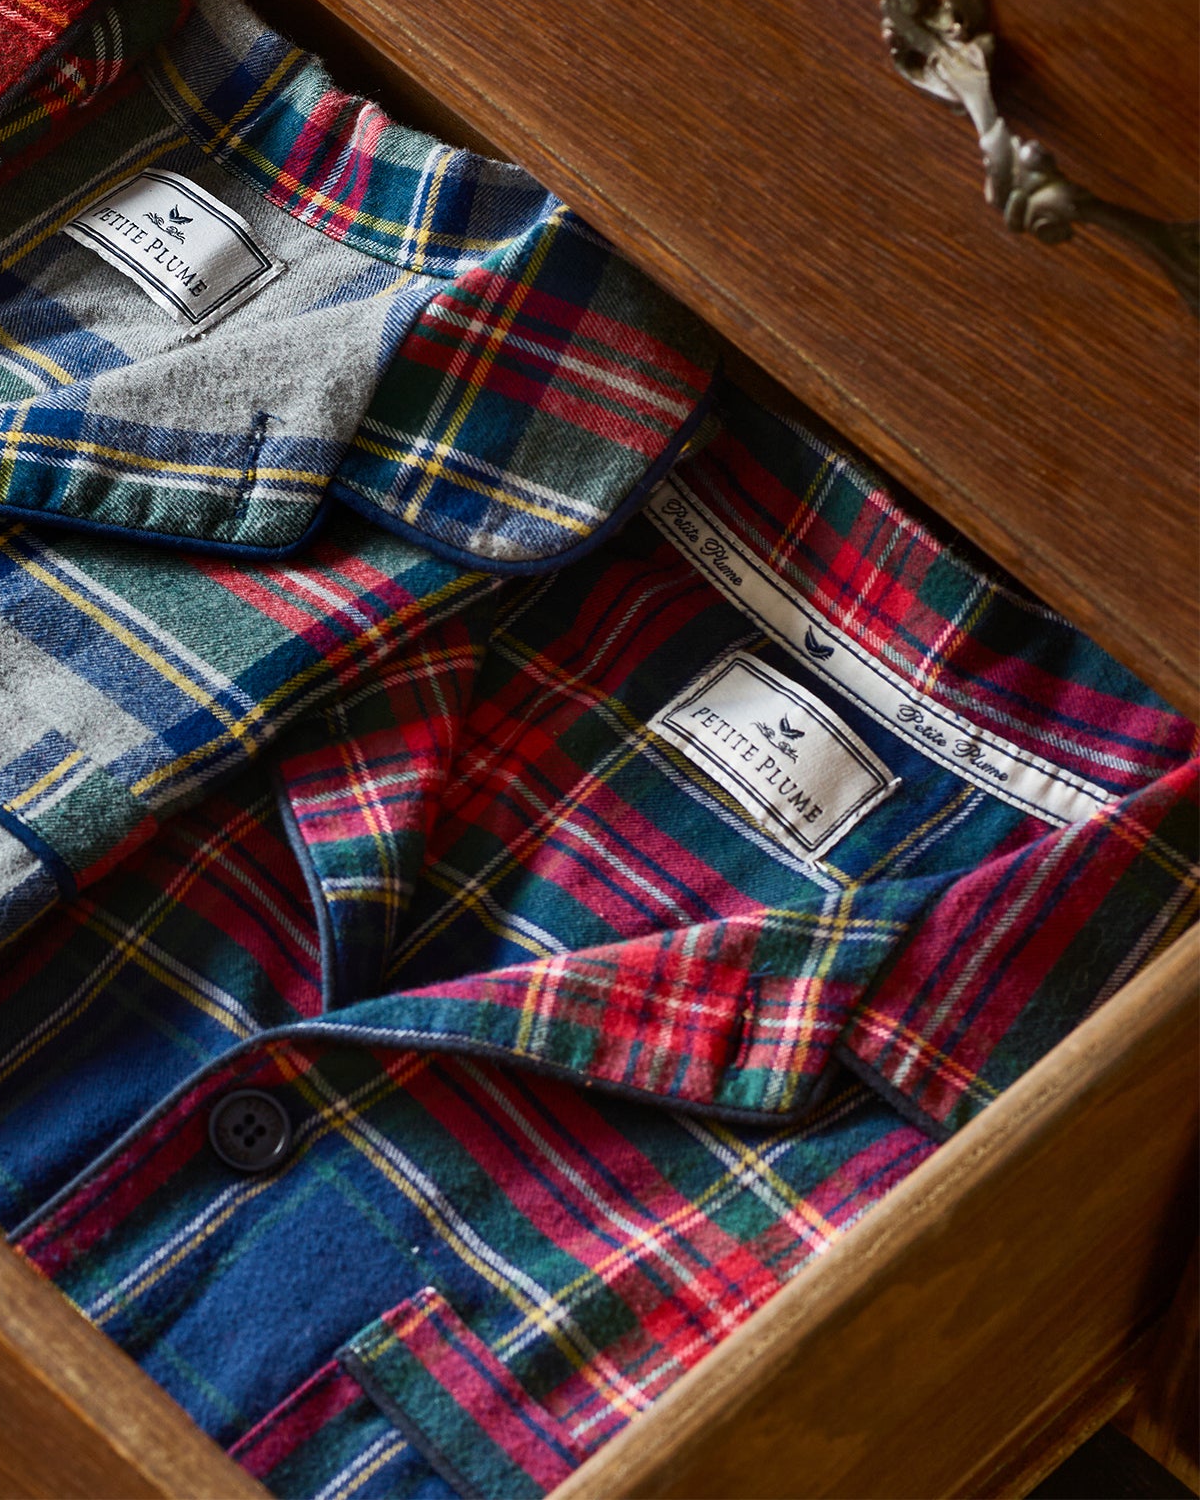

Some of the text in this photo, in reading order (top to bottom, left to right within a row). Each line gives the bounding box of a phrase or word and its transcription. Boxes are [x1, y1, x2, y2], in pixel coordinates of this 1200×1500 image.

[93, 207, 208, 297] PETITE PLUME
[661, 498, 743, 587] Petite Plume
[689, 706, 823, 823] PETITE PLUME
[896, 704, 1009, 782] Petite Plume
